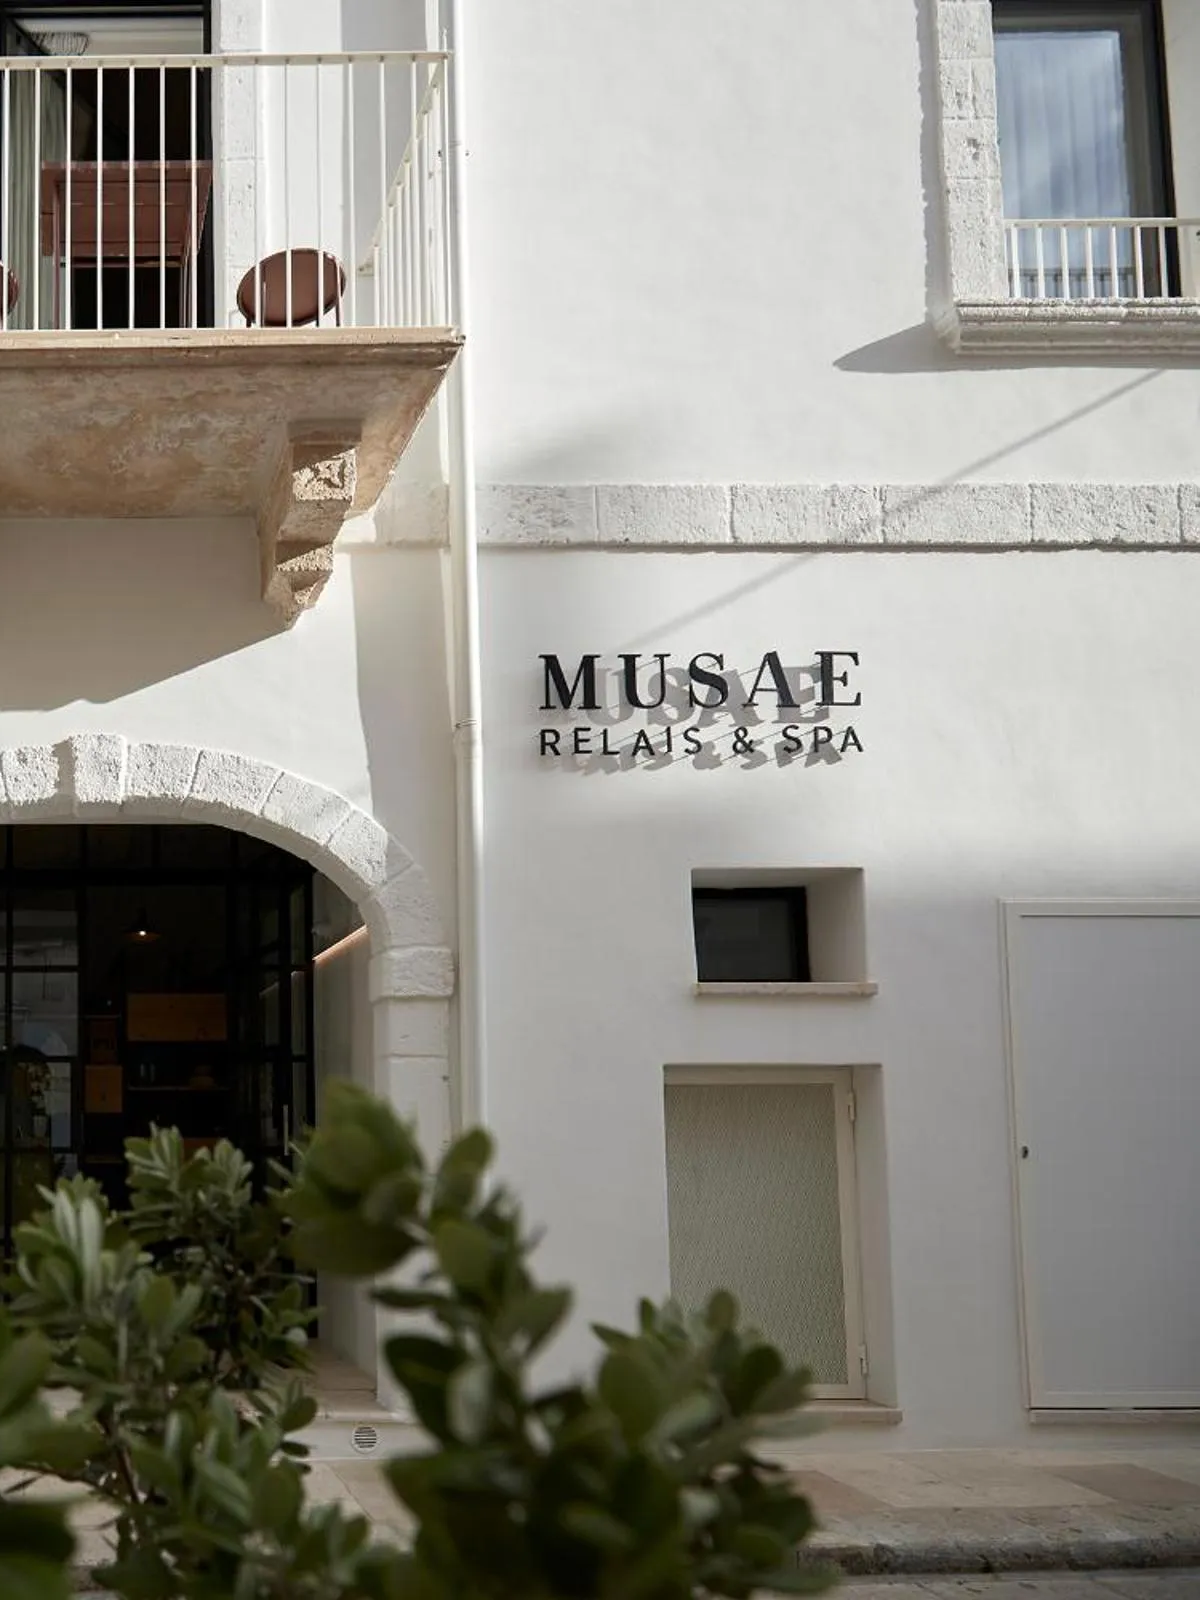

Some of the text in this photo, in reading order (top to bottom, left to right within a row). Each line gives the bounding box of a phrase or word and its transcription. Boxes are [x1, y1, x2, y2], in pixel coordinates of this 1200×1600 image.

[538, 650, 862, 710] MUSAE
[540, 724, 864, 756] RELAIS & SPA
